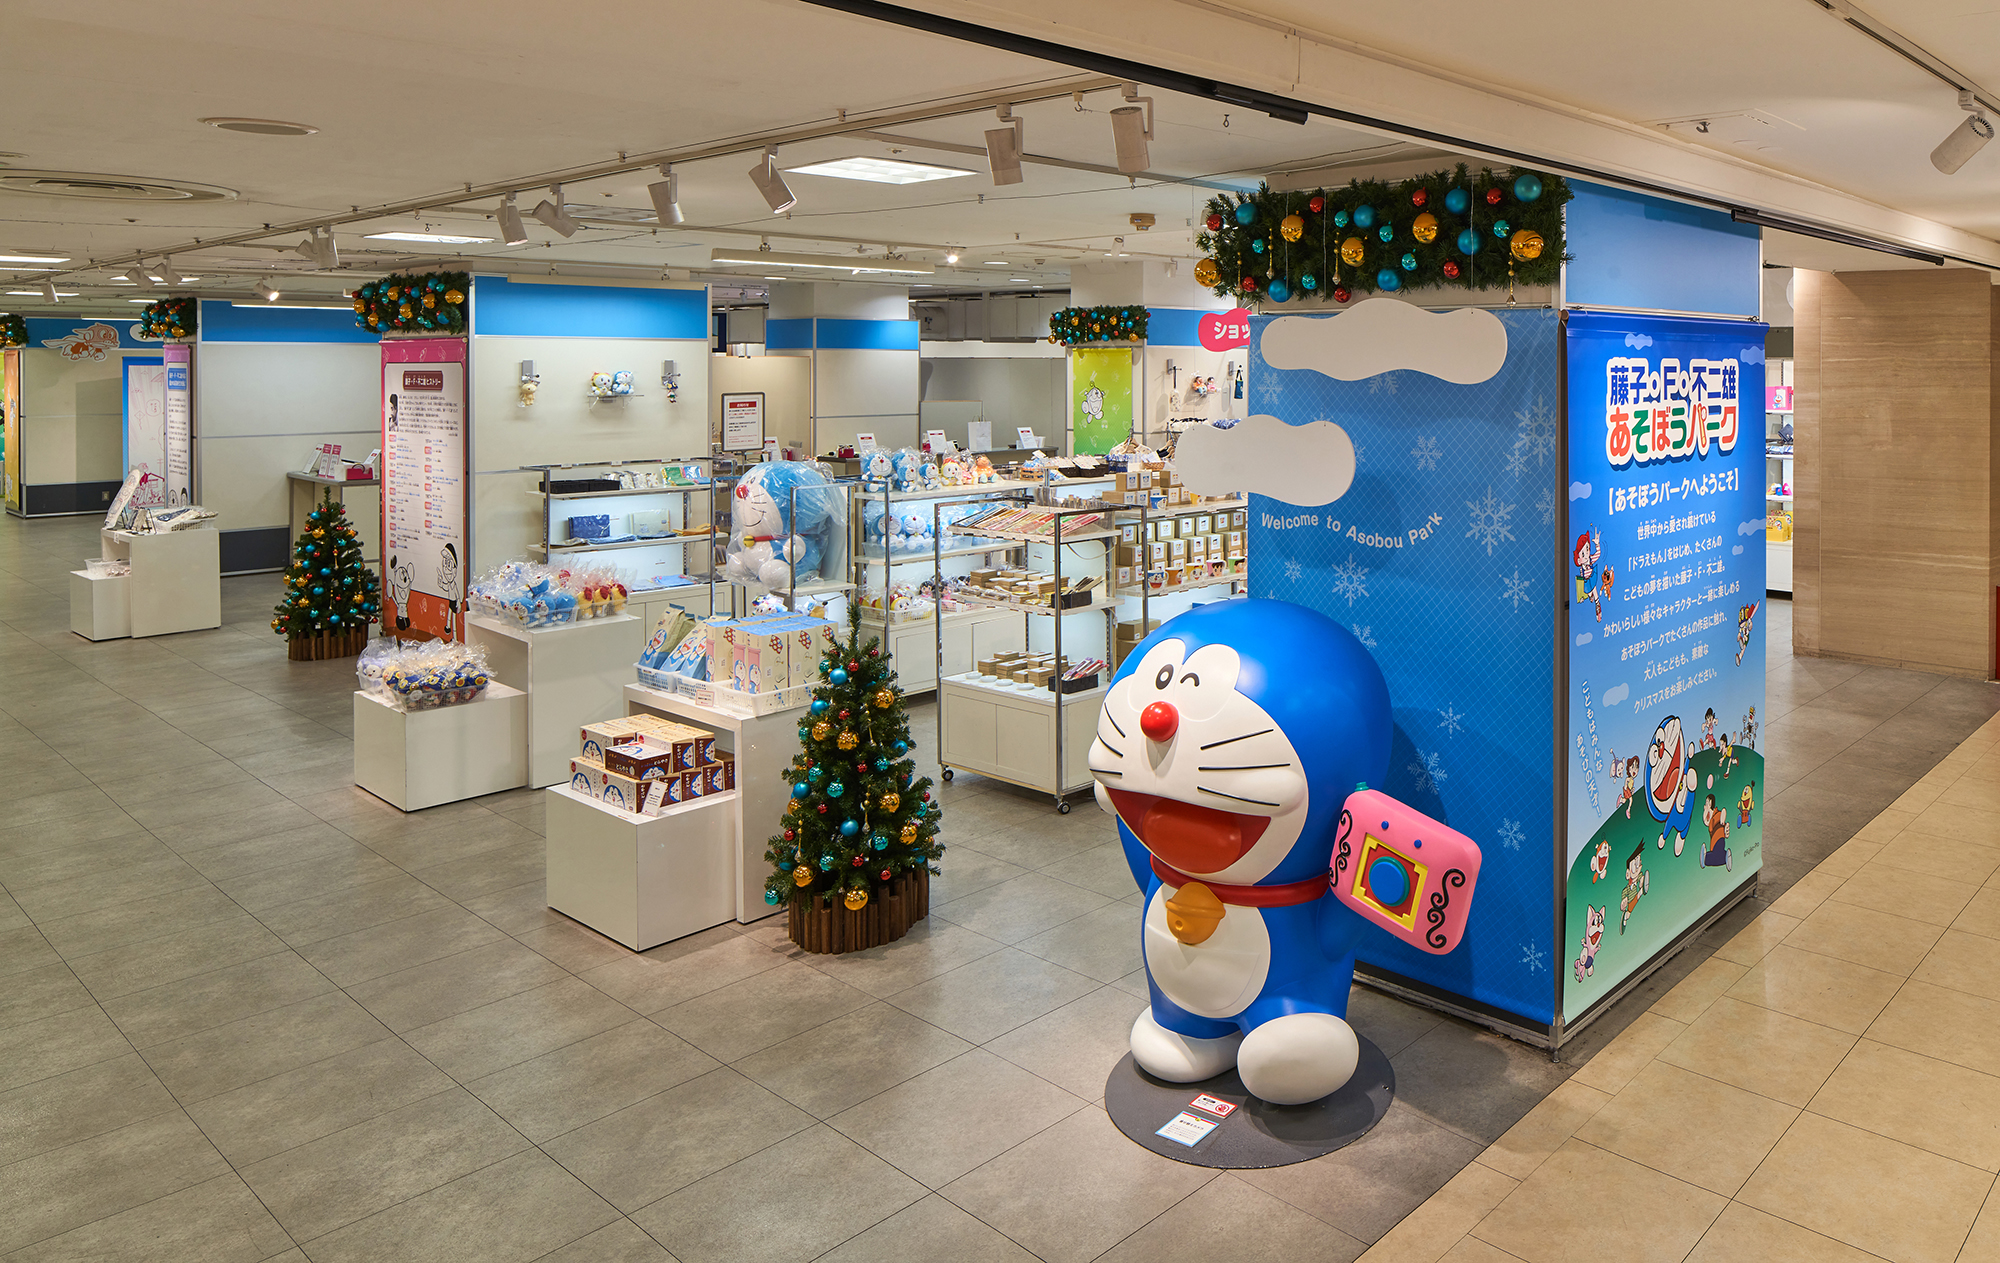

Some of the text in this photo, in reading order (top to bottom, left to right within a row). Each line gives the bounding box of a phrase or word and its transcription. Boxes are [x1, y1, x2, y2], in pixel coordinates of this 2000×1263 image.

[1609, 364, 1738, 407] 藤子・F・不二雄
[1609, 403, 1738, 457] あそぼうパーク
[1608, 467, 1739, 516] 【あそぼうパークへようこそ】
[1261, 512, 1443, 549] Welcome to Asobou Park
[1636, 510, 1717, 542] 世界中から愛され続けている
[1627, 534, 1723, 572] 「ドラえもん」をはじめ、たくさんの
[1623, 560, 1726, 602] こどもの夢を描いた藤子・F・不二雄。
[1603, 580, 1741, 638] かわいらしい様々なキャラクターと一緒に楽しめる
[1620, 611, 1728, 662] あそぼうパークでたくさんの作品に触れ、
[1643, 643, 1710, 682] 大人もこどもも、素敵な
[1633, 667, 1718, 714] クリスマスをお楽しみください。
[1581, 680, 1603, 773] こどもはみんな
